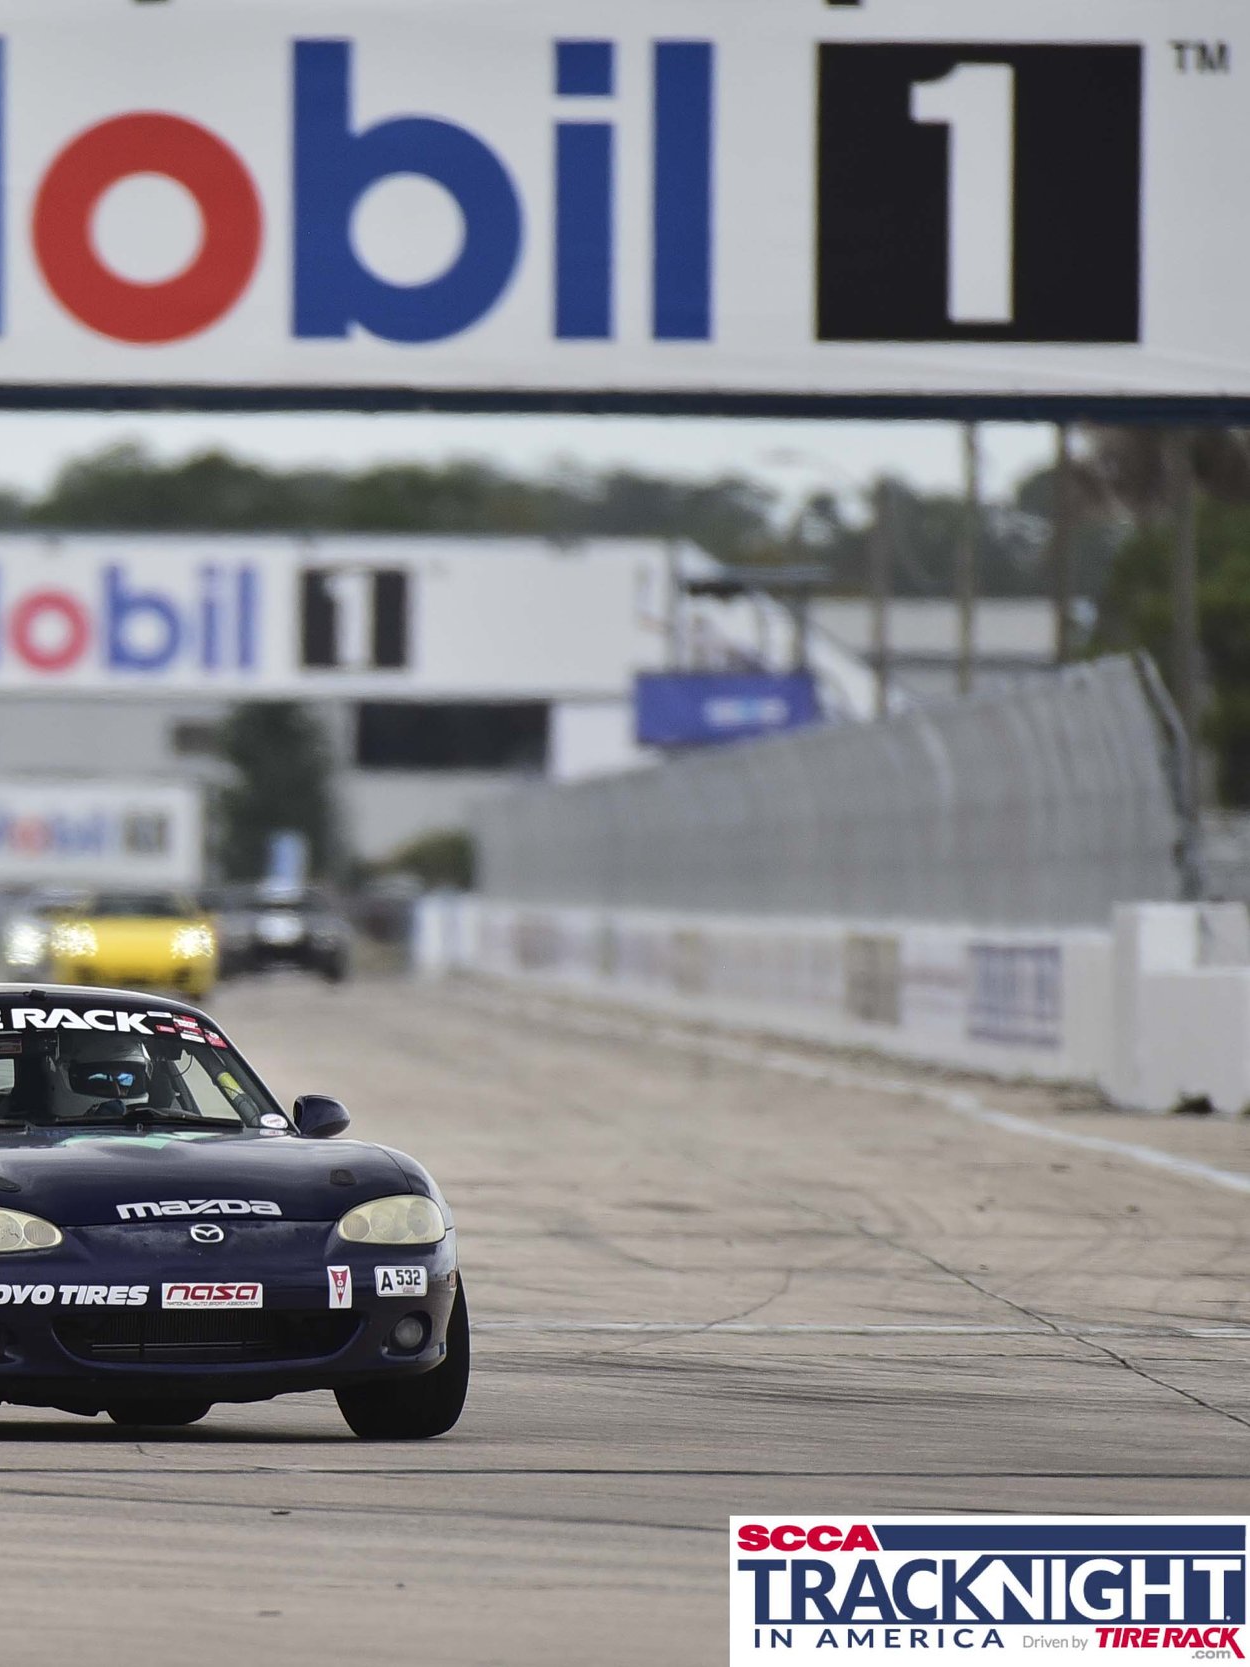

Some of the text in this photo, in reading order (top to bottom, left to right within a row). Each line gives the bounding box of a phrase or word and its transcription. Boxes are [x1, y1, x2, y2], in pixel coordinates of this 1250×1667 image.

[11, 1007, 155, 1035] RACK
[336, 1272, 345, 1293] TOW
[380, 1269, 421, 1291] A 532
[58, 1284, 150, 1306] TIRES
